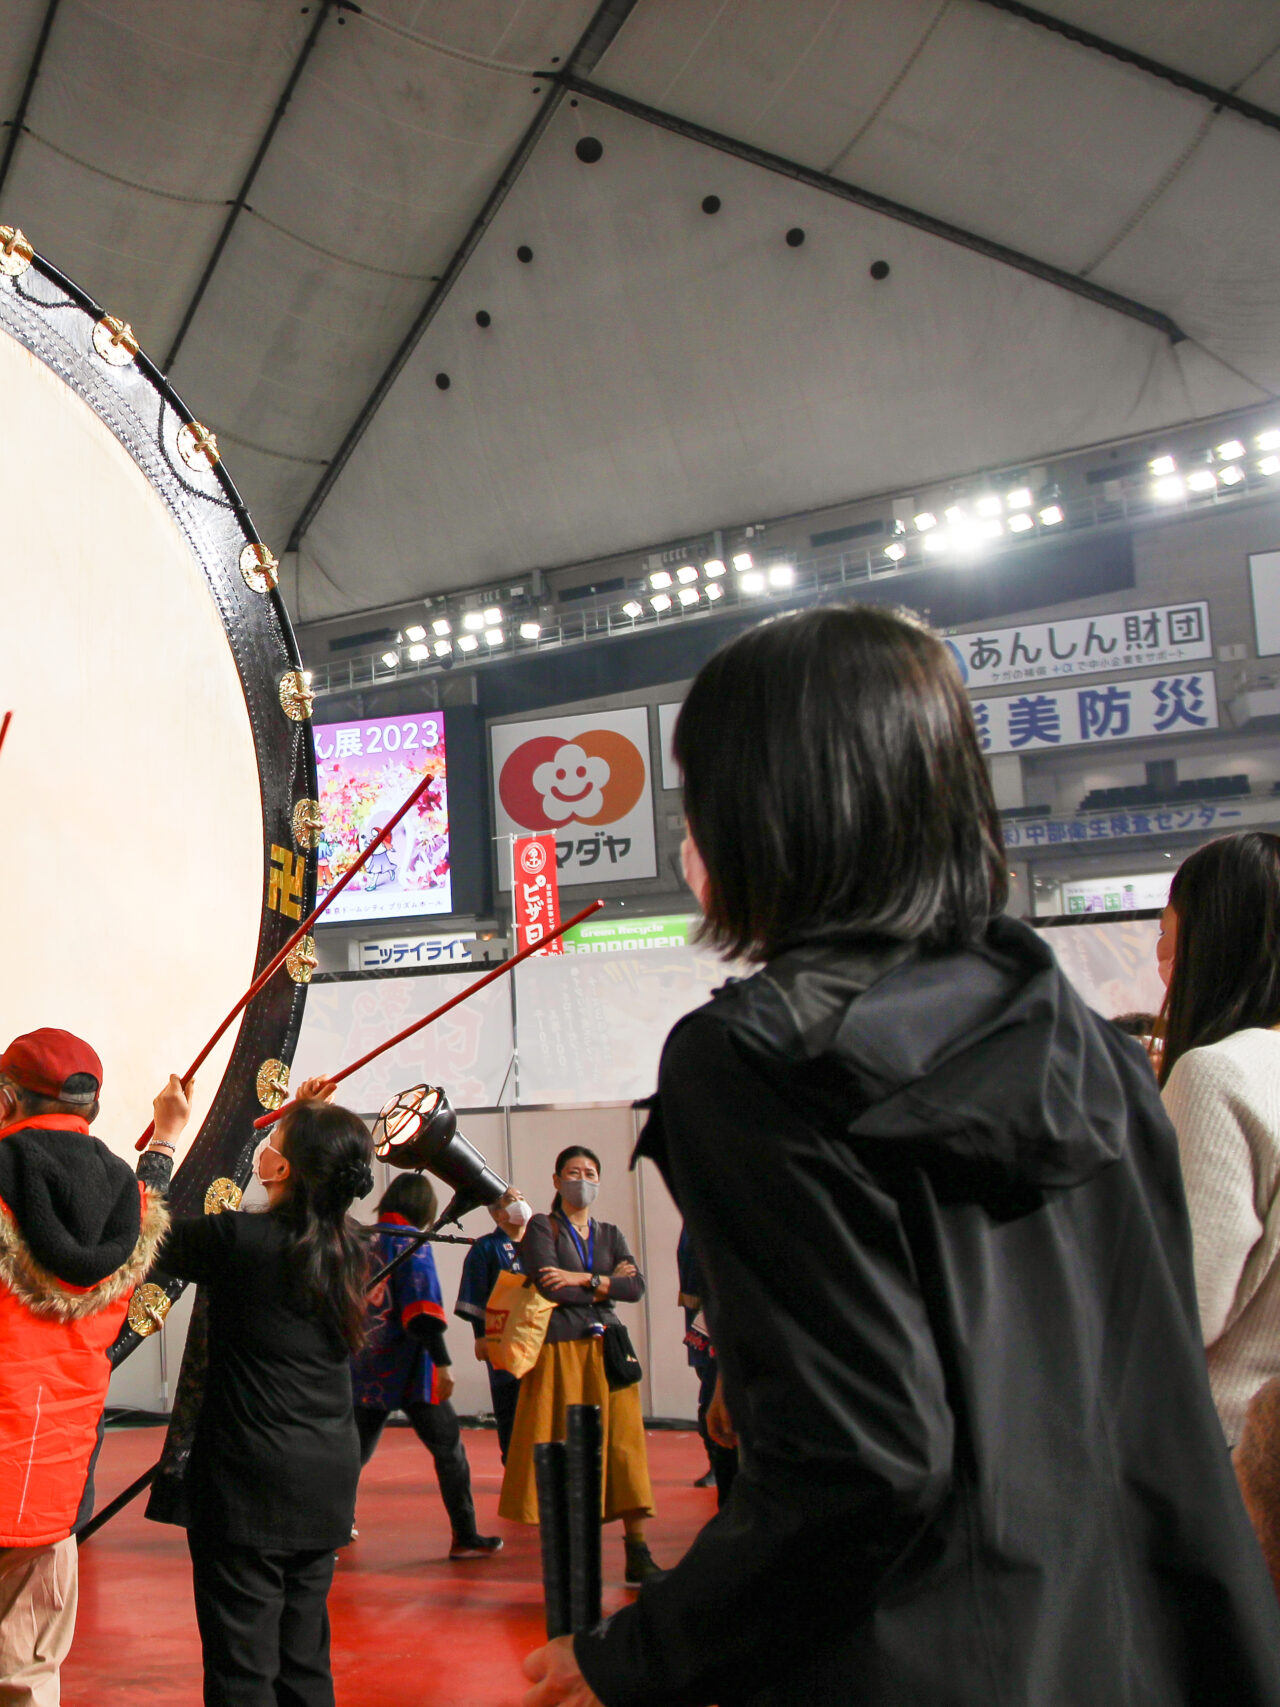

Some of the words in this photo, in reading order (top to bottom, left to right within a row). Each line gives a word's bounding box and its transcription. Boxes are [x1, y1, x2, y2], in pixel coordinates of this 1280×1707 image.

[970, 607, 1205, 670] あんしん財団
[580, 927, 616, 938] Green
